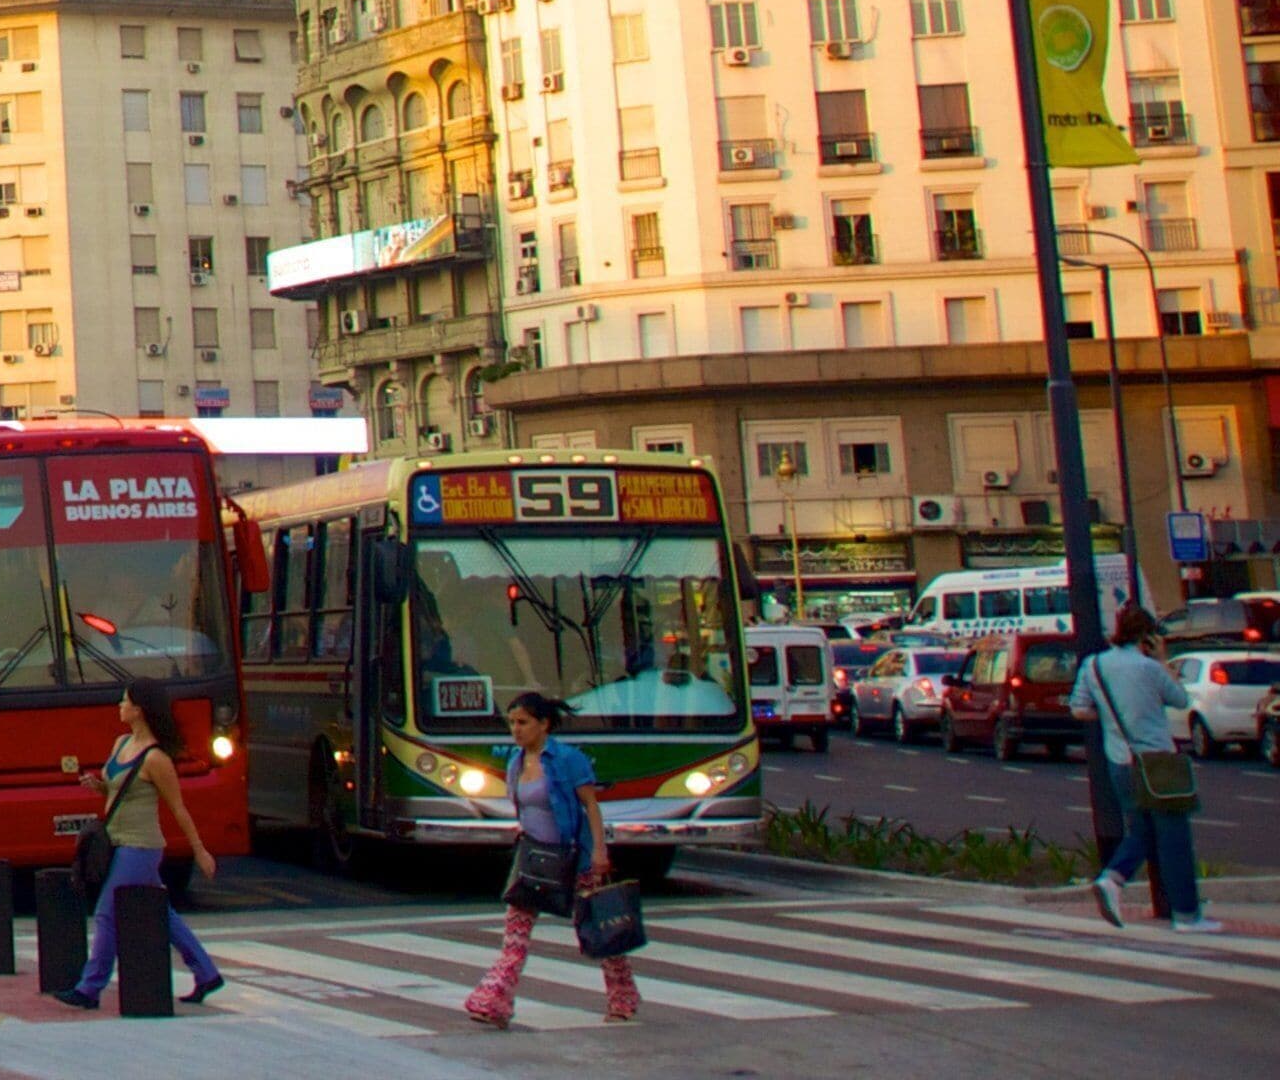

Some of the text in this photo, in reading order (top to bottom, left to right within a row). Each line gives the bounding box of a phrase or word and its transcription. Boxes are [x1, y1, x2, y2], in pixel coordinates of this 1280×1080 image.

[62, 476, 196, 502] LA PLATA
[517, 476, 615, 517] 59
[65, 501, 198, 522] BUENOS AIRES
